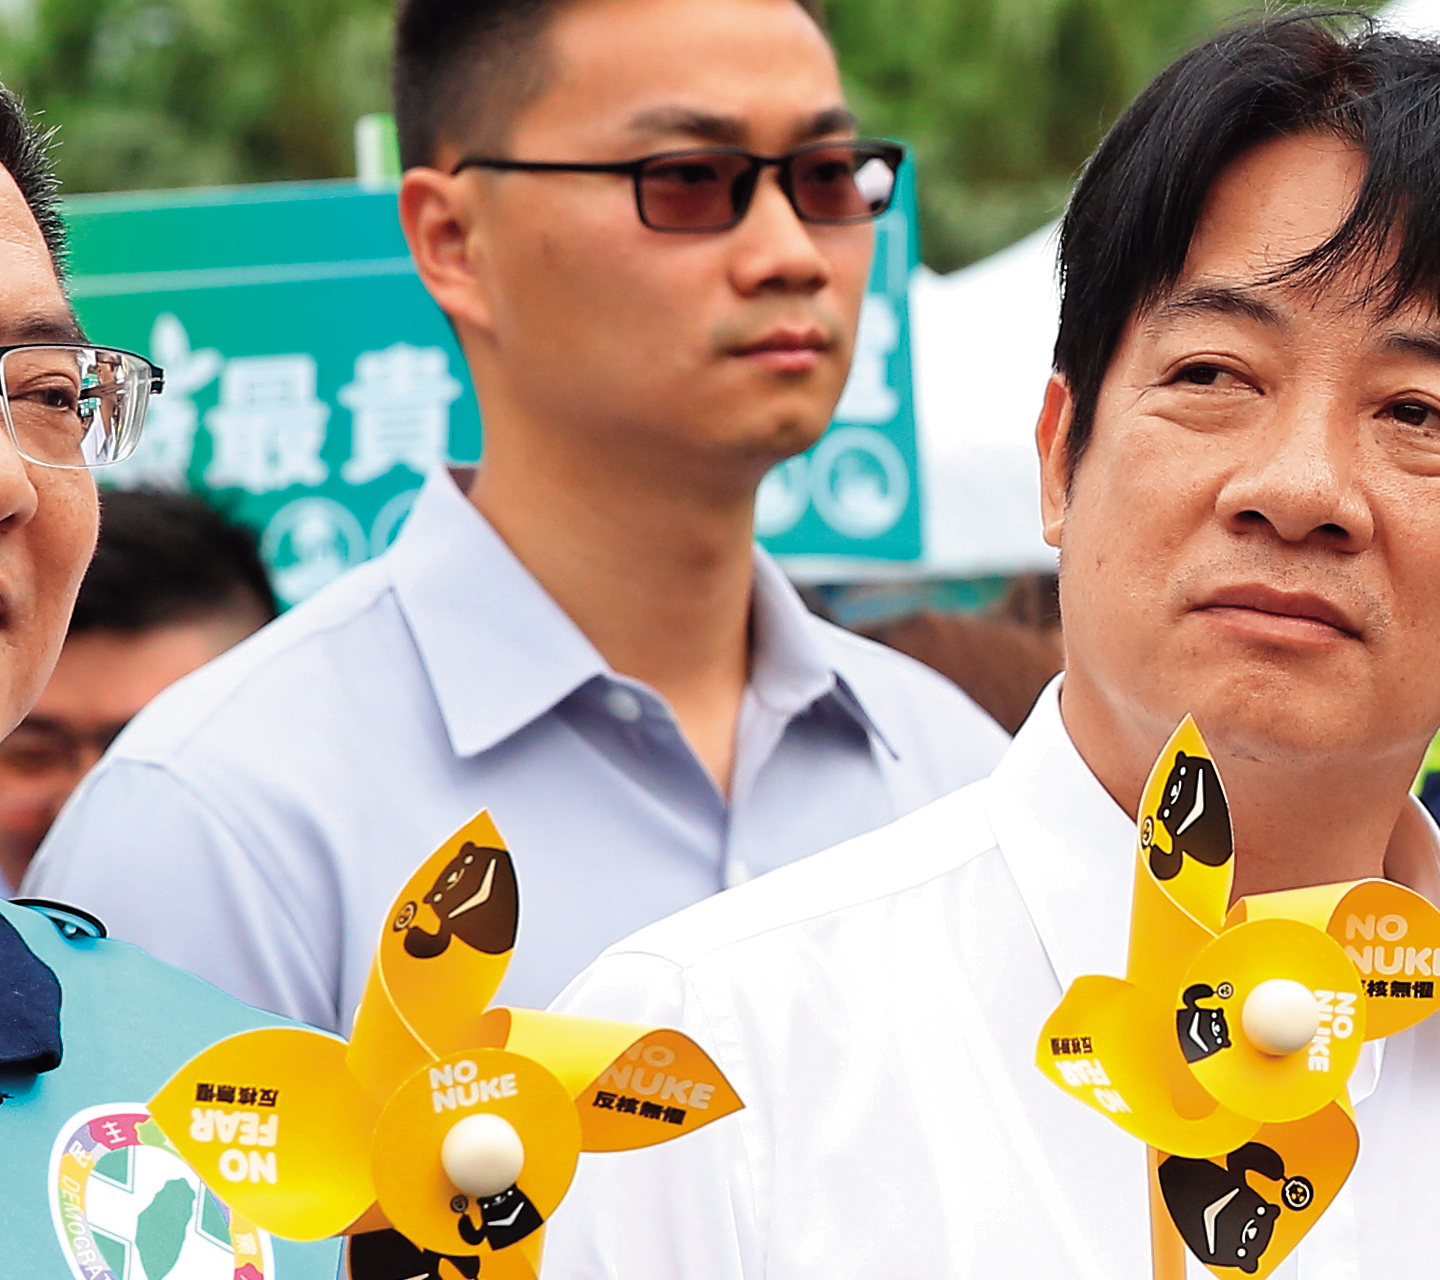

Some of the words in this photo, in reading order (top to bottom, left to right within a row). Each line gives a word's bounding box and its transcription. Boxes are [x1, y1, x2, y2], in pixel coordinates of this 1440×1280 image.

[1345, 914, 1408, 942] NO
[1360, 979, 1435, 999] 核無懼
[1331, 991, 1358, 1039] NO
[625, 1041, 676, 1068] NO
[428, 1059, 479, 1090] NO
[597, 1064, 716, 1110] NUKE
[1053, 1057, 1113, 1087] FEAR
[431, 1072, 519, 1114] NUKE
[1092, 1086, 1133, 1114] NO
[189, 1106, 279, 1148] FEAR
[218, 1147, 279, 1185] NO
